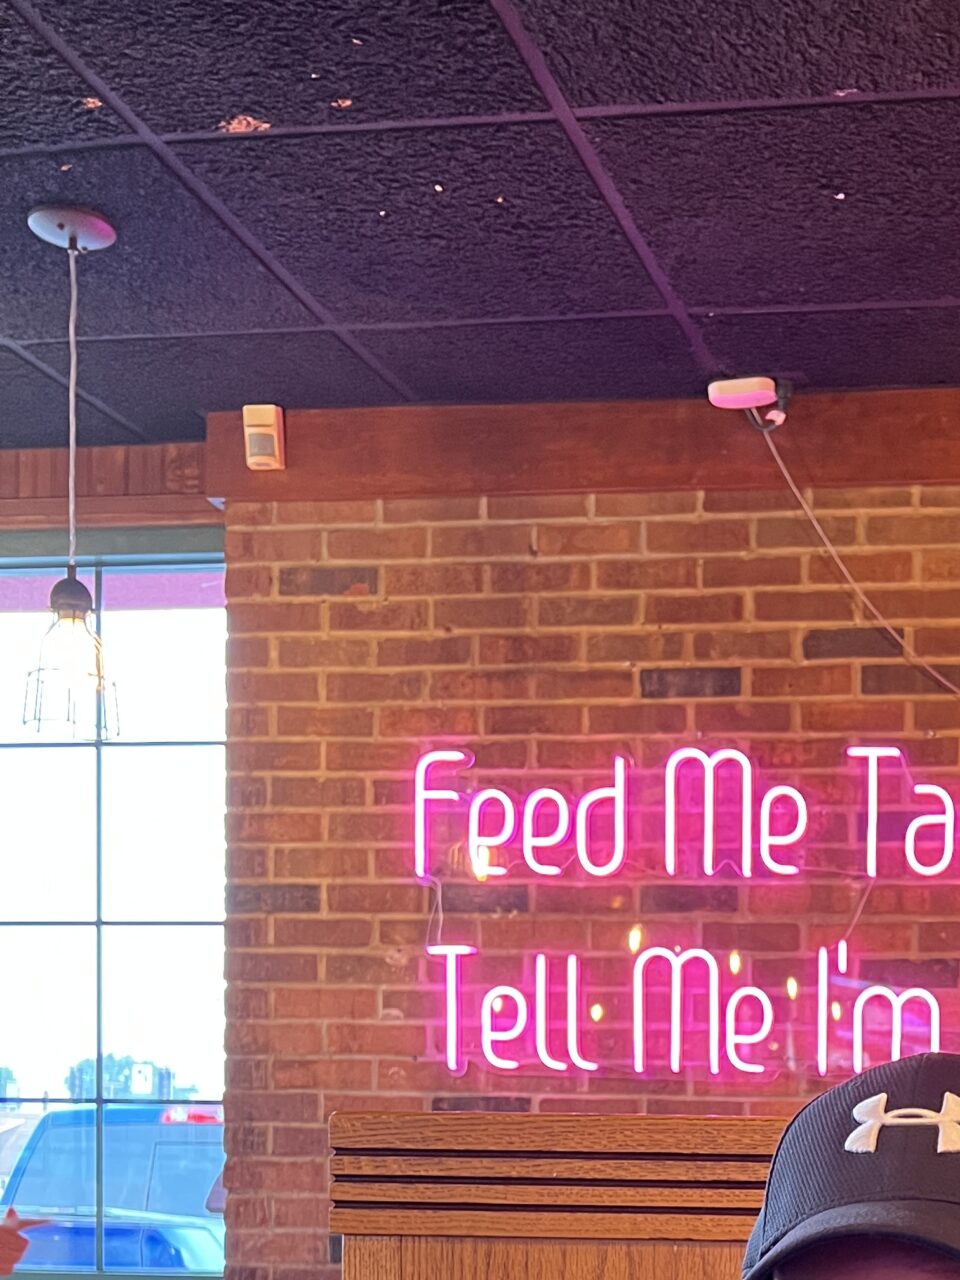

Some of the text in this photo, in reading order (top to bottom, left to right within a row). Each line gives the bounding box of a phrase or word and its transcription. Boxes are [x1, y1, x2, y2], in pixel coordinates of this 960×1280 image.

[415, 749, 631, 878] Feed
[665, 748, 807, 877] Me
[428, 945, 598, 1072] Tell
[634, 946, 775, 1074] Me
[819, 939, 941, 1075] I'm
